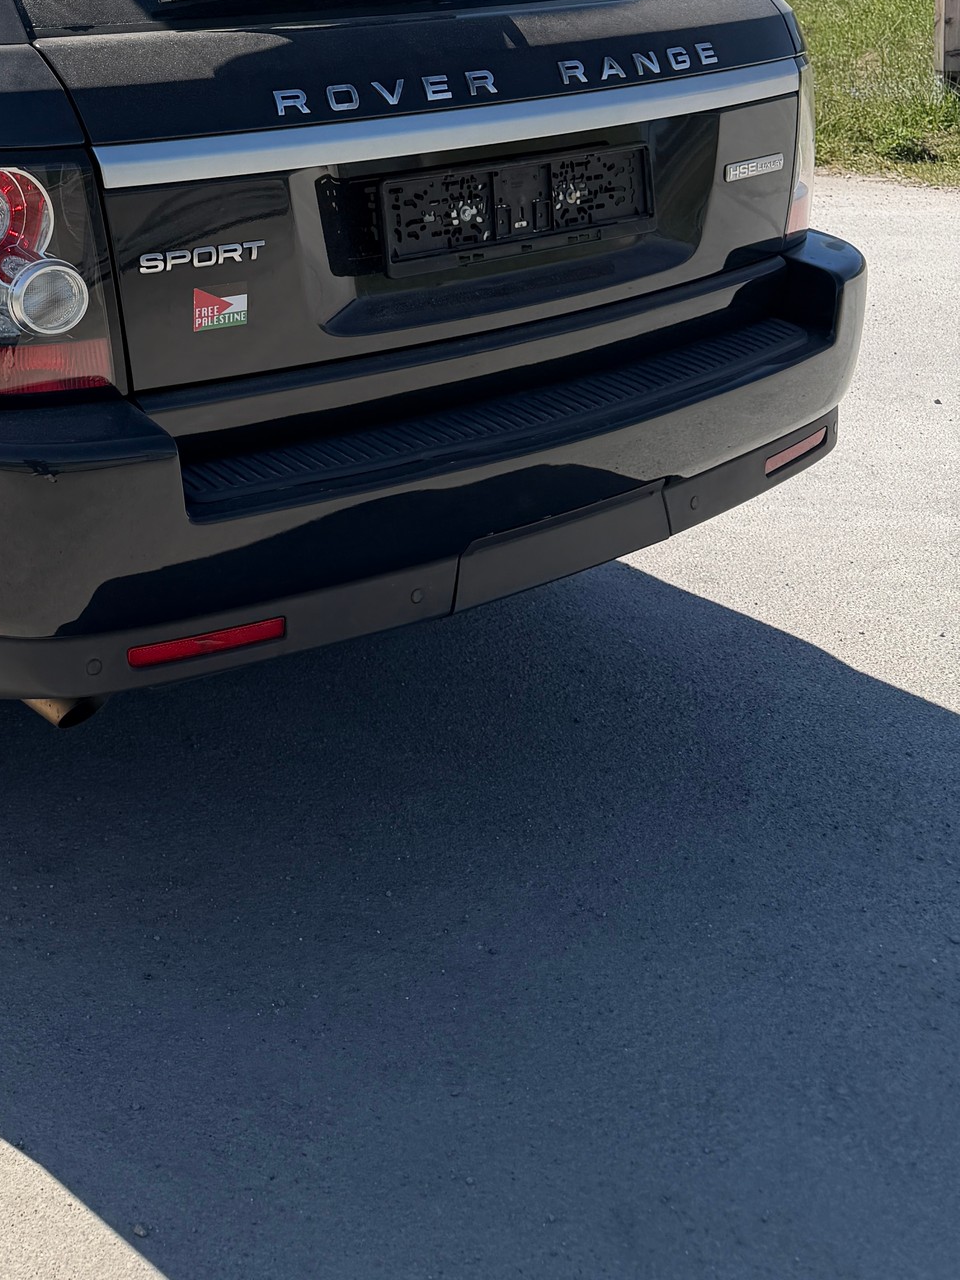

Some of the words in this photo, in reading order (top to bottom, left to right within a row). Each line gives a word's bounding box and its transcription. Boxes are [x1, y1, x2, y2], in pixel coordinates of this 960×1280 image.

[272, 69, 499, 117] ROVER
[557, 41, 720, 86] RANGE
[730, 162, 757, 179] HSE
[757, 158, 783, 171] LUXURY
[139, 239, 266, 275] SPORT
[195, 305, 220, 318] FREE
[195, 311, 246, 328] PALESTINE
